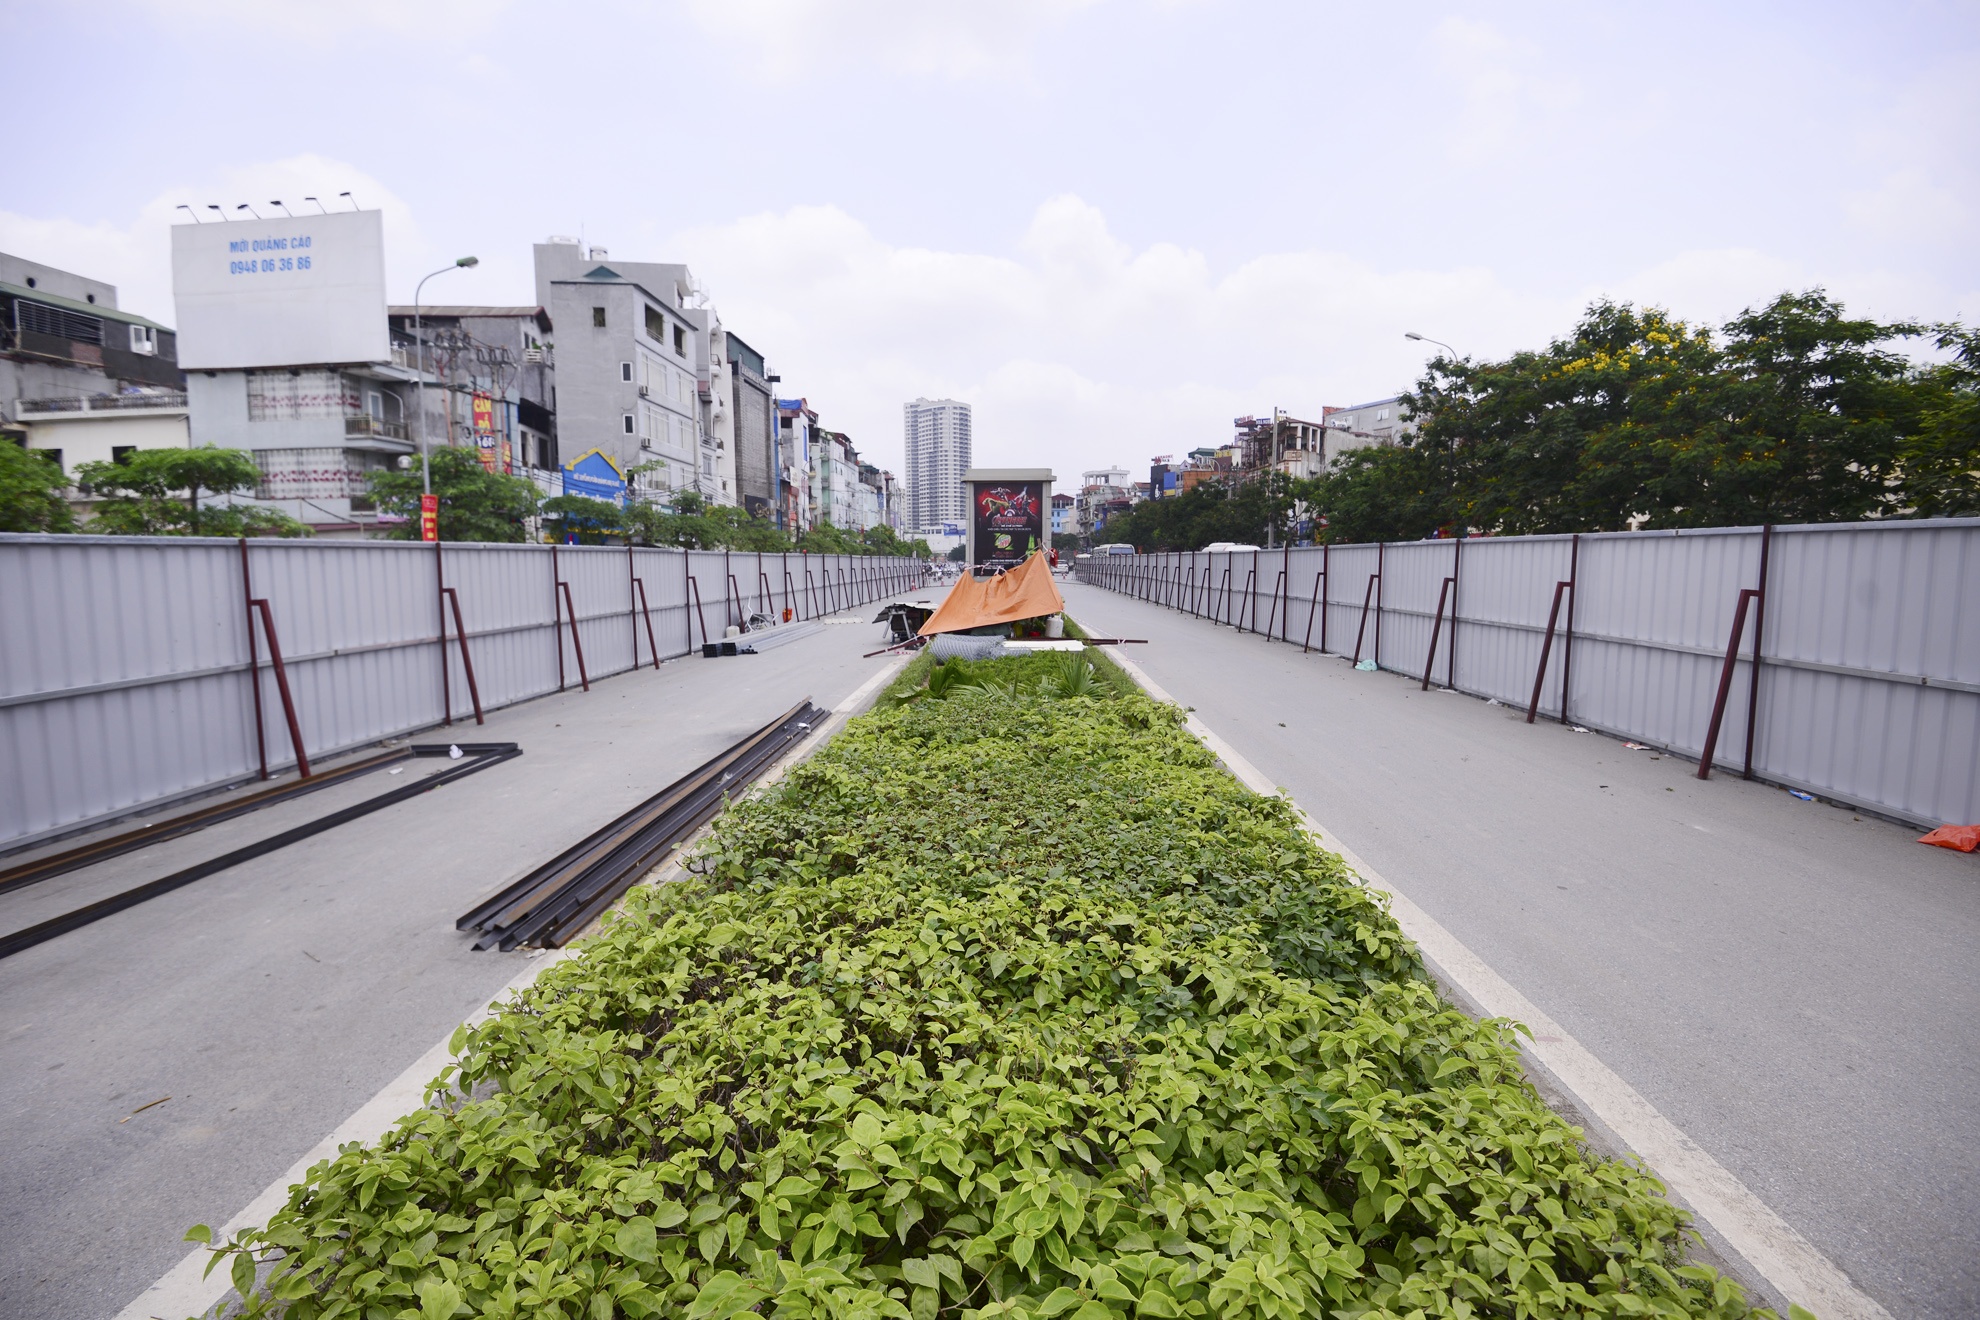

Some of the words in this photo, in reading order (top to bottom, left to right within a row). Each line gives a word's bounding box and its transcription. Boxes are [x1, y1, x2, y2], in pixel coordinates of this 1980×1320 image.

[230, 260, 257, 275] 0948
[261, 259, 275, 272] 06
[279, 257, 293, 271] 36
[297, 256, 311, 270] 86
